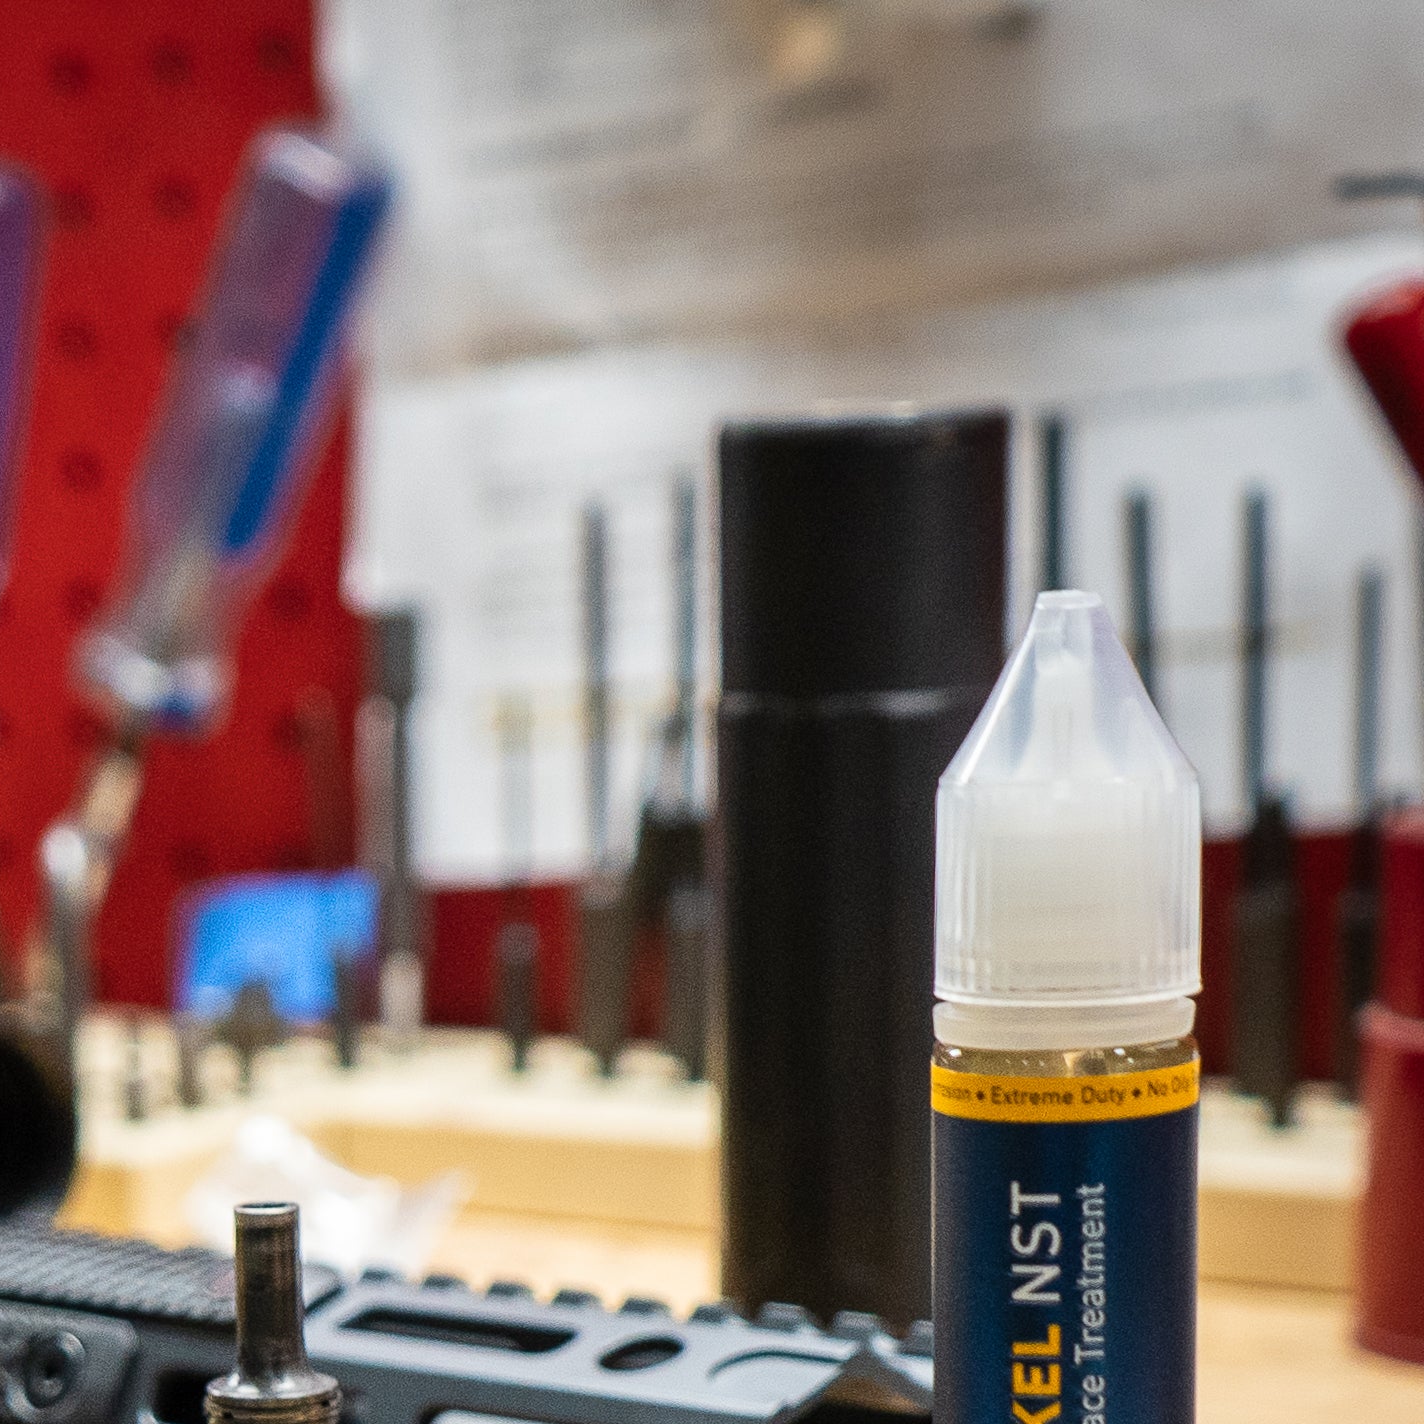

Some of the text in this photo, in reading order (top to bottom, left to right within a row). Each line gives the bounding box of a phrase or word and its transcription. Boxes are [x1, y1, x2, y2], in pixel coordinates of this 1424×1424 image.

[990, 1085, 1074, 1105] Extreme
[1080, 1085, 1125, 1106] Duty
[1147, 1080, 1168, 1097] No
[1010, 1180, 1062, 1304] NST
[1074, 1181, 1106, 1366] Treatment
